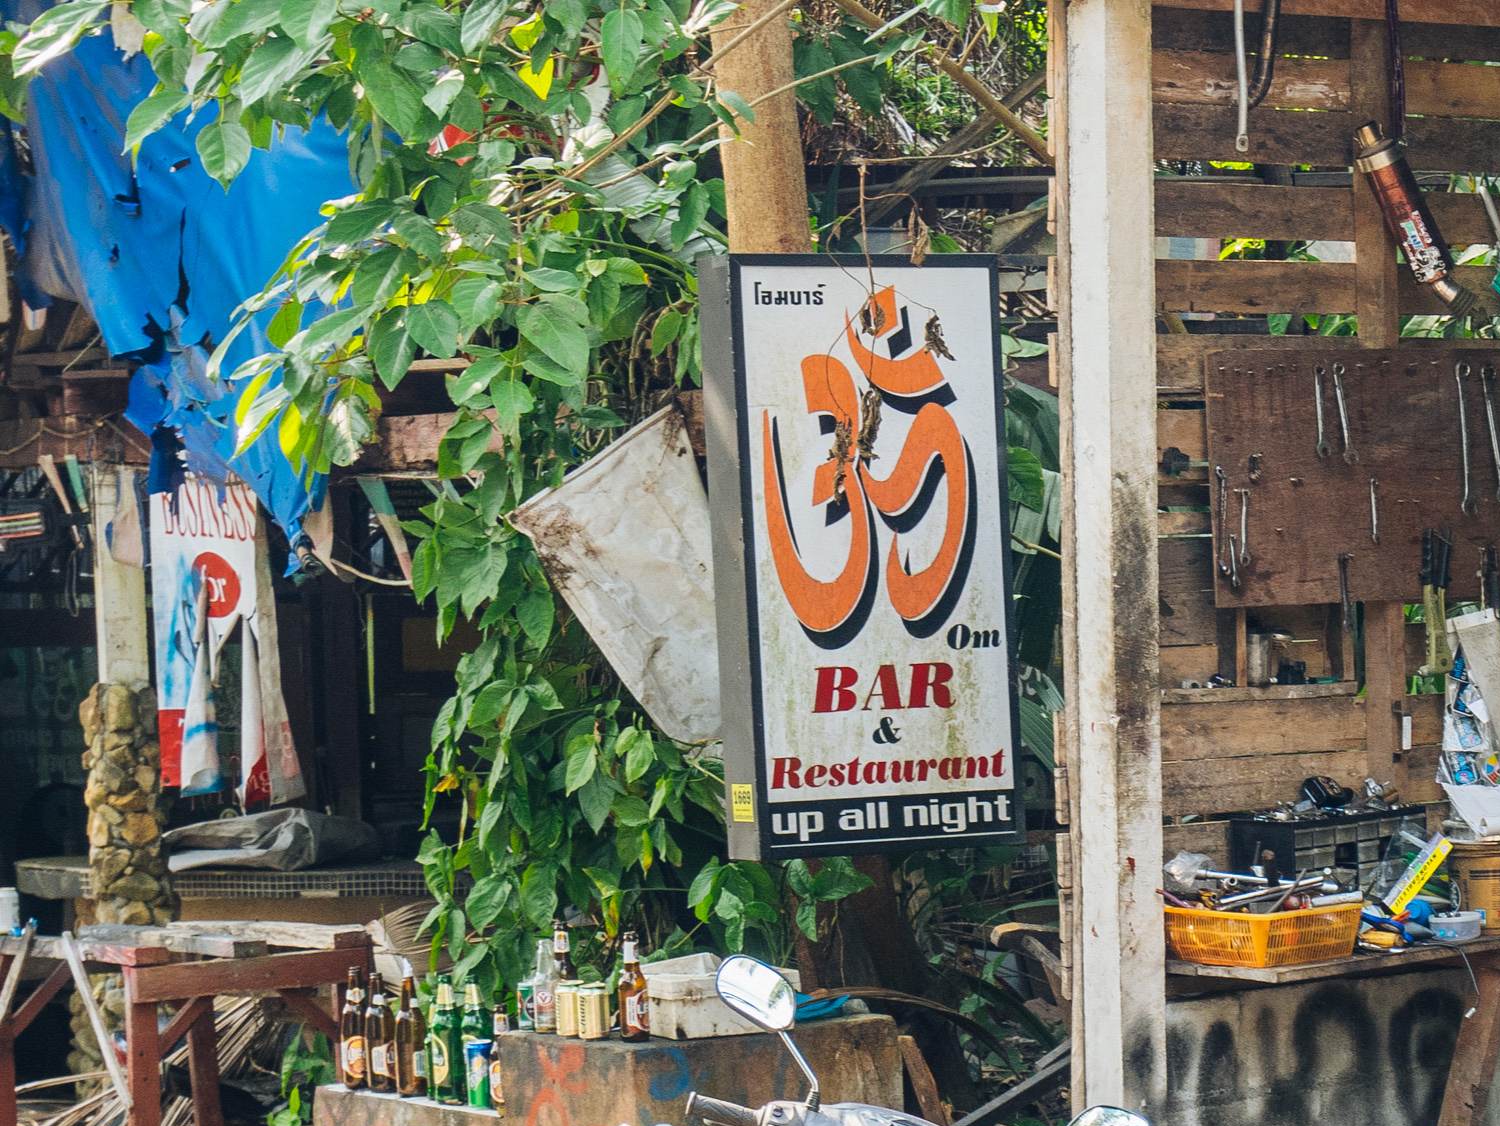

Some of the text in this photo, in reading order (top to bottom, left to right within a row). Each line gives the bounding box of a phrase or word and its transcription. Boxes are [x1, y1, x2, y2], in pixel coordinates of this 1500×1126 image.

[754, 281, 827, 305] โอมบาร์
[946, 623, 1001, 651] Om
[812, 662, 956, 714] BAR
[872, 716, 902, 745] &
[771, 748, 1007, 790] Restaurant
[772, 794, 1012, 842] up all night
